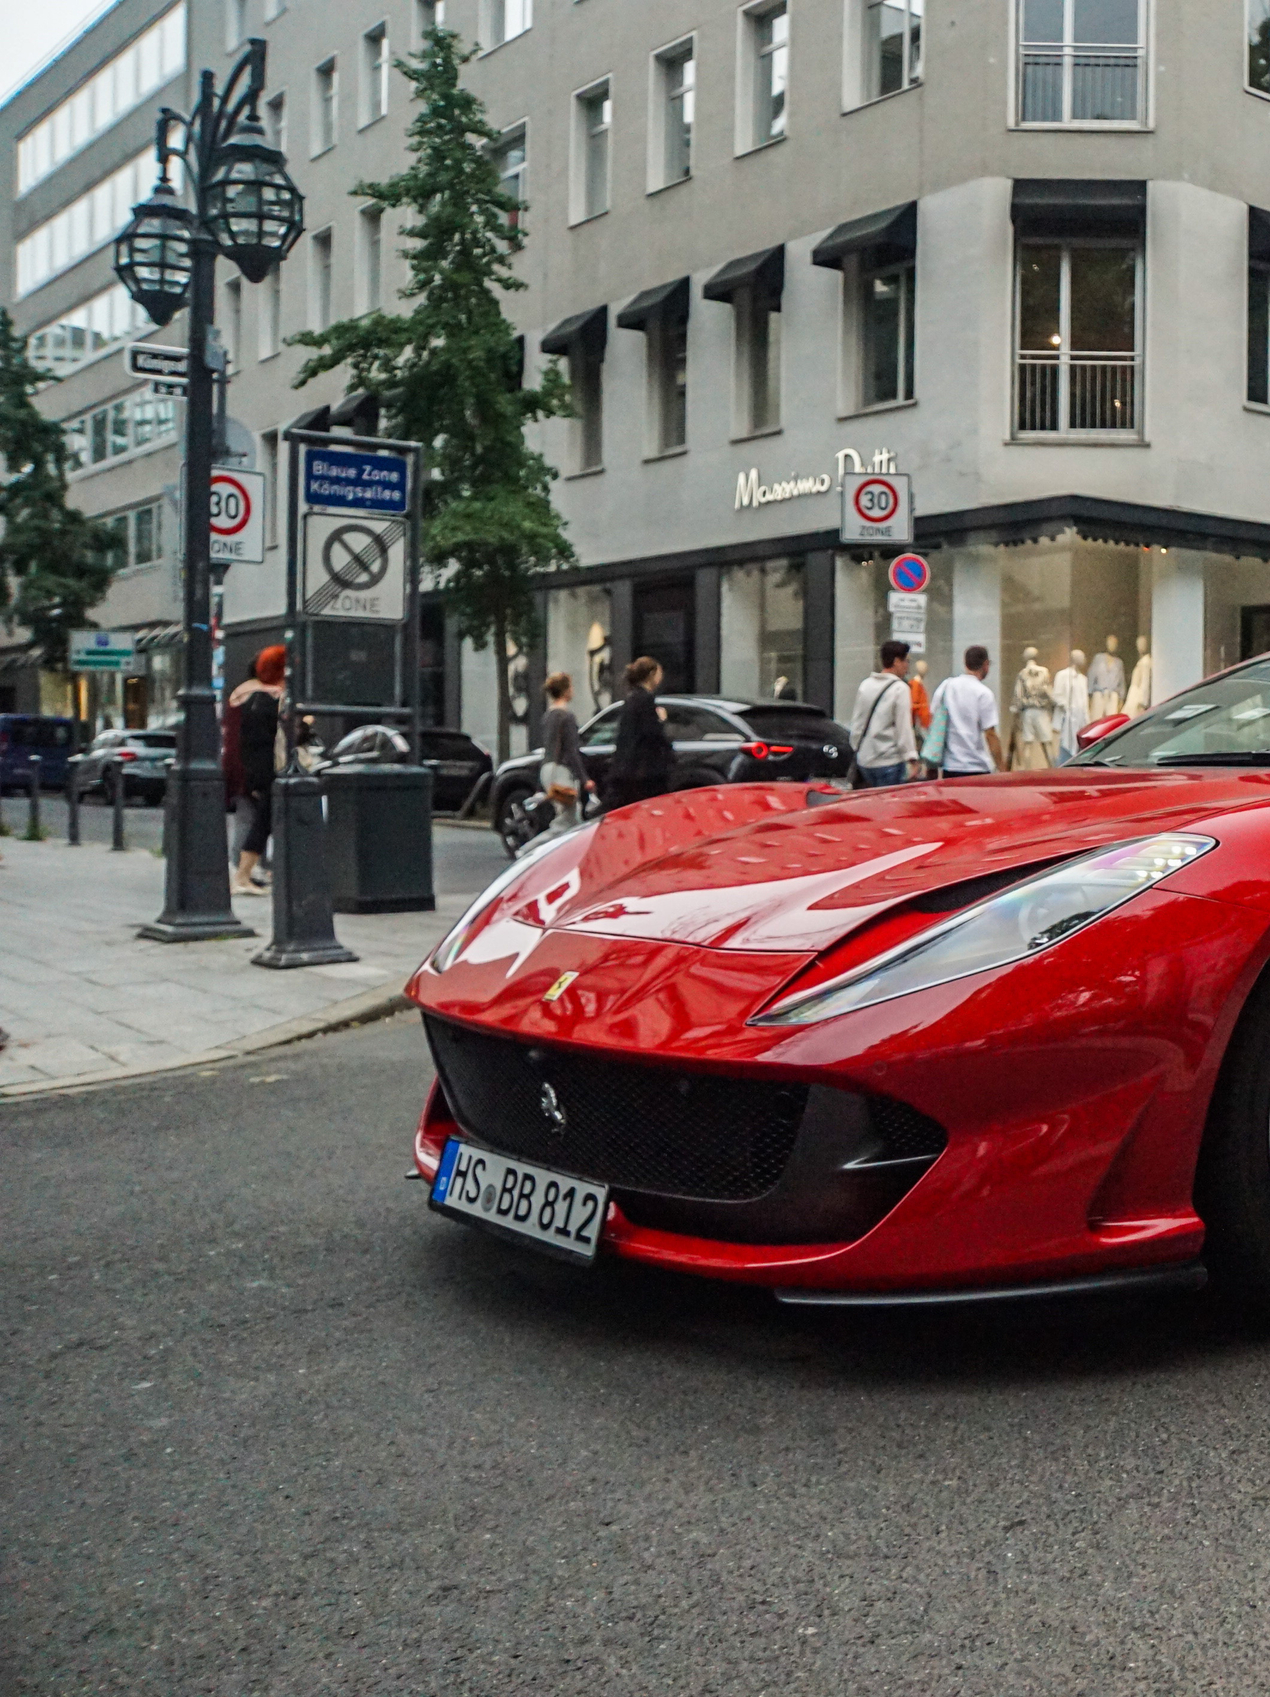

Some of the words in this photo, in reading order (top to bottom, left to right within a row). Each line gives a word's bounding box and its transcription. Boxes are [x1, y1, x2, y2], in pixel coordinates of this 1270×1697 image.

[312, 460, 357, 479] Blaue
[362, 465, 401, 484] Zone
[310, 479, 403, 501] Königsallee
[734, 467, 832, 512] Massimo
[863, 490, 890, 511] 30
[211, 490, 240, 520] 30
[858, 525, 893, 537] ZONE
[211, 540, 245, 556] ONE
[329, 595, 381, 614] ZONE
[450, 1151, 486, 1204] HS
[495, 1166, 536, 1223] BB
[538, 1179, 599, 1245] 812
